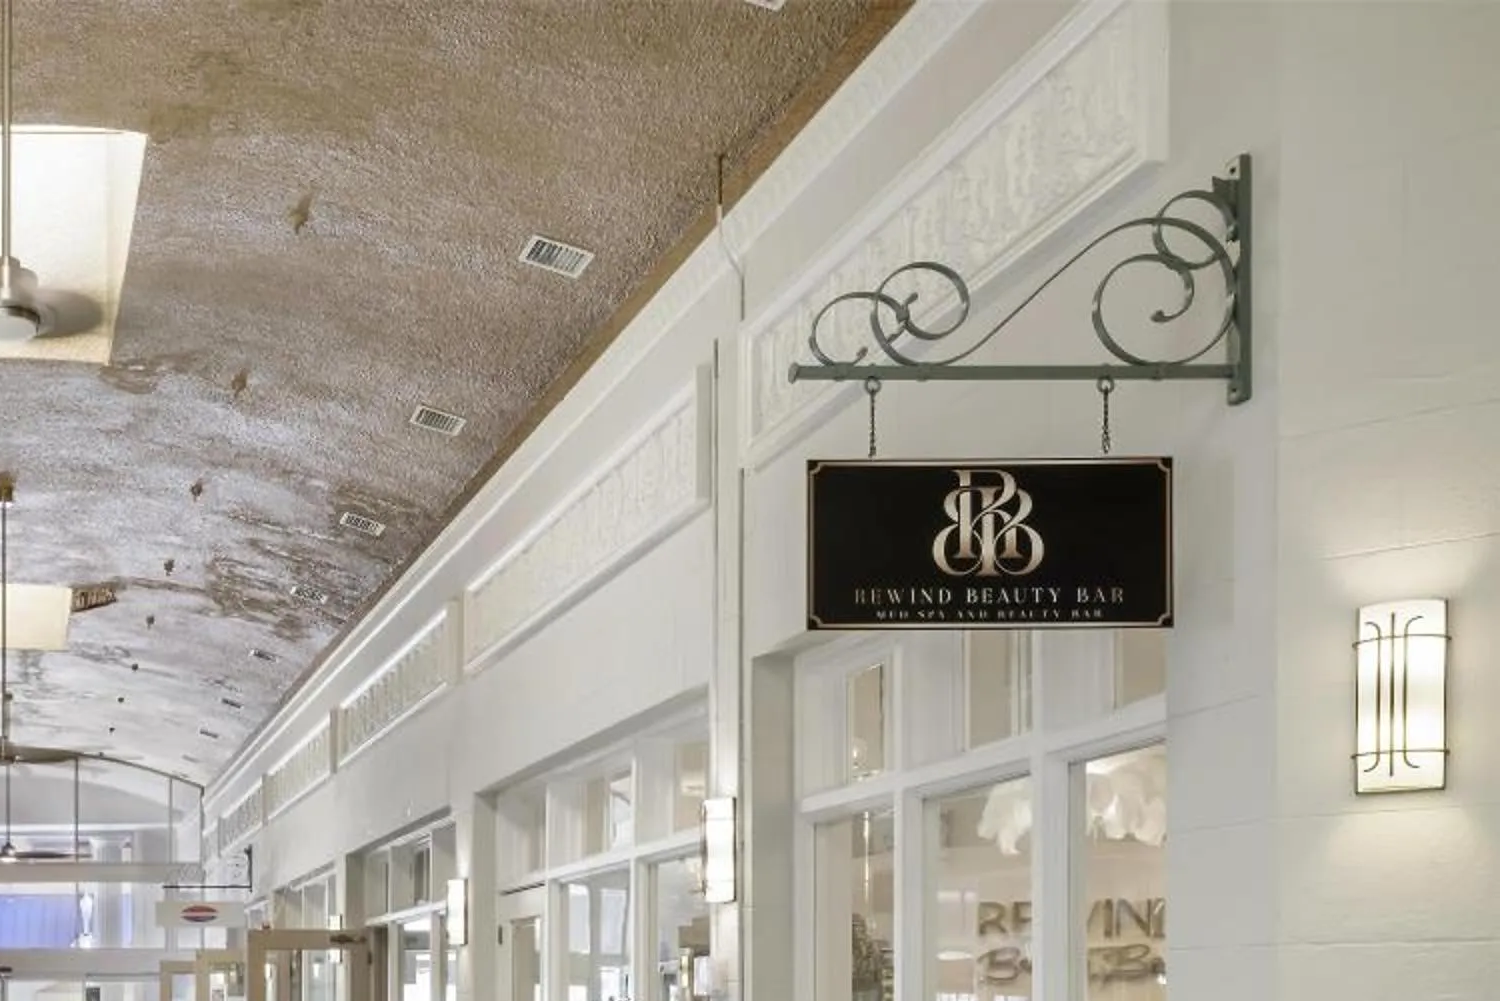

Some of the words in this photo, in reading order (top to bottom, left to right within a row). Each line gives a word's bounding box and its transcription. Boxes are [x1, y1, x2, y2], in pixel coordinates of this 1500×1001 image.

[855, 588, 952, 604] REWIND
[966, 587, 1062, 604] BEAUTY
[1076, 586, 1125, 604] BAR
[876, 609, 909, 620] MED
[918, 609, 946, 620] SPA
[956, 609, 988, 619] AND
[998, 608, 1061, 619] BEAUTY
[1071, 608, 1104, 618] BAR
